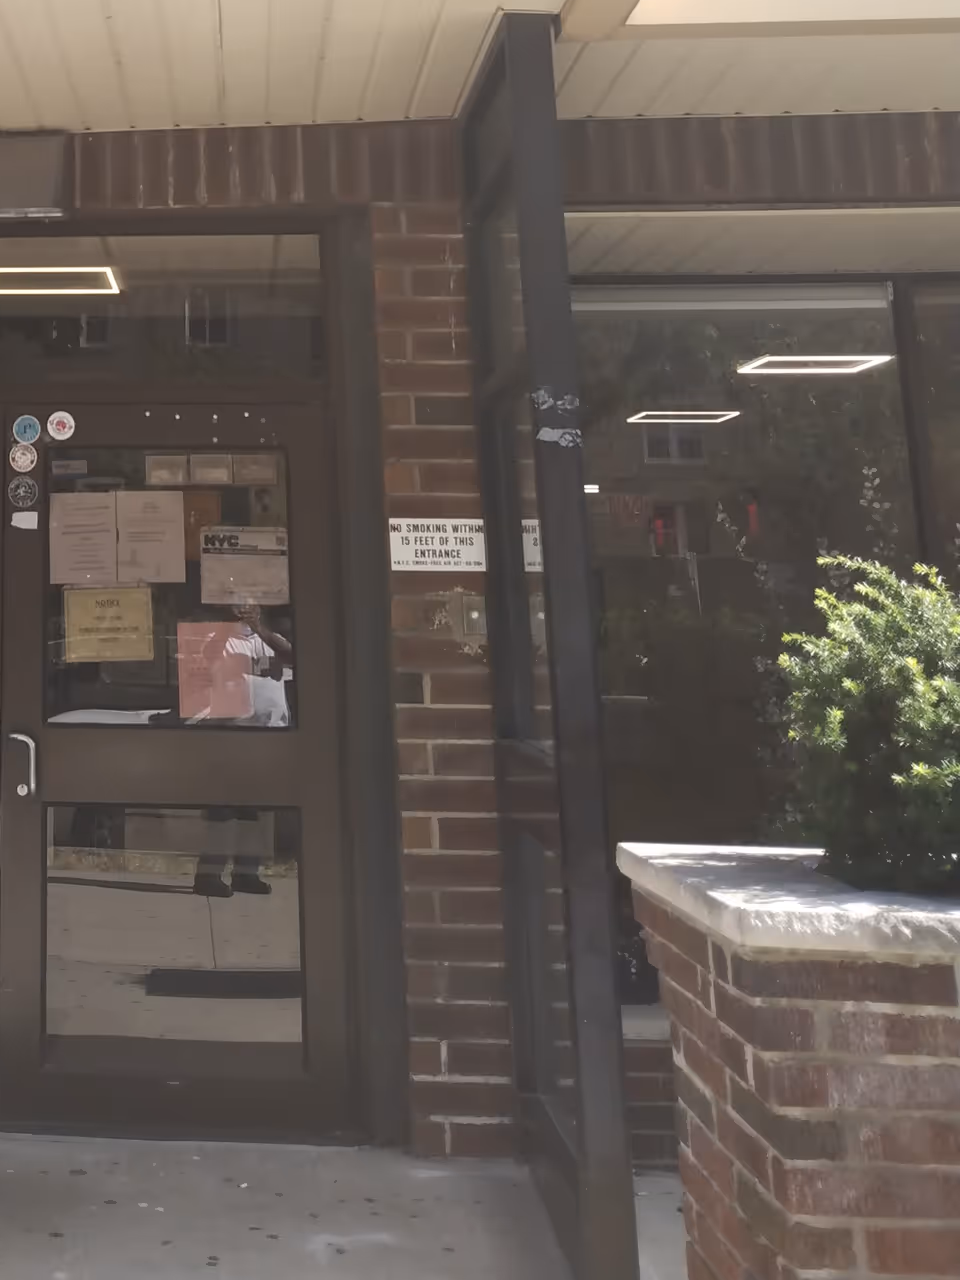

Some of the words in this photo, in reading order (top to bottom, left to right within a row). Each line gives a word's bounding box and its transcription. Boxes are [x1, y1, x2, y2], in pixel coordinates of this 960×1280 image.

[390, 523, 402, 533] NO
[406, 523, 447, 534] SMOKING
[451, 524, 485, 534] WITHIN
[204, 534, 239, 547] NYC
[401, 536, 410, 546] 15
[414, 536, 435, 546] FEET
[439, 536, 449, 546] OF
[453, 536, 474, 547] THIS
[414, 548, 462, 559] ENTRANCE
